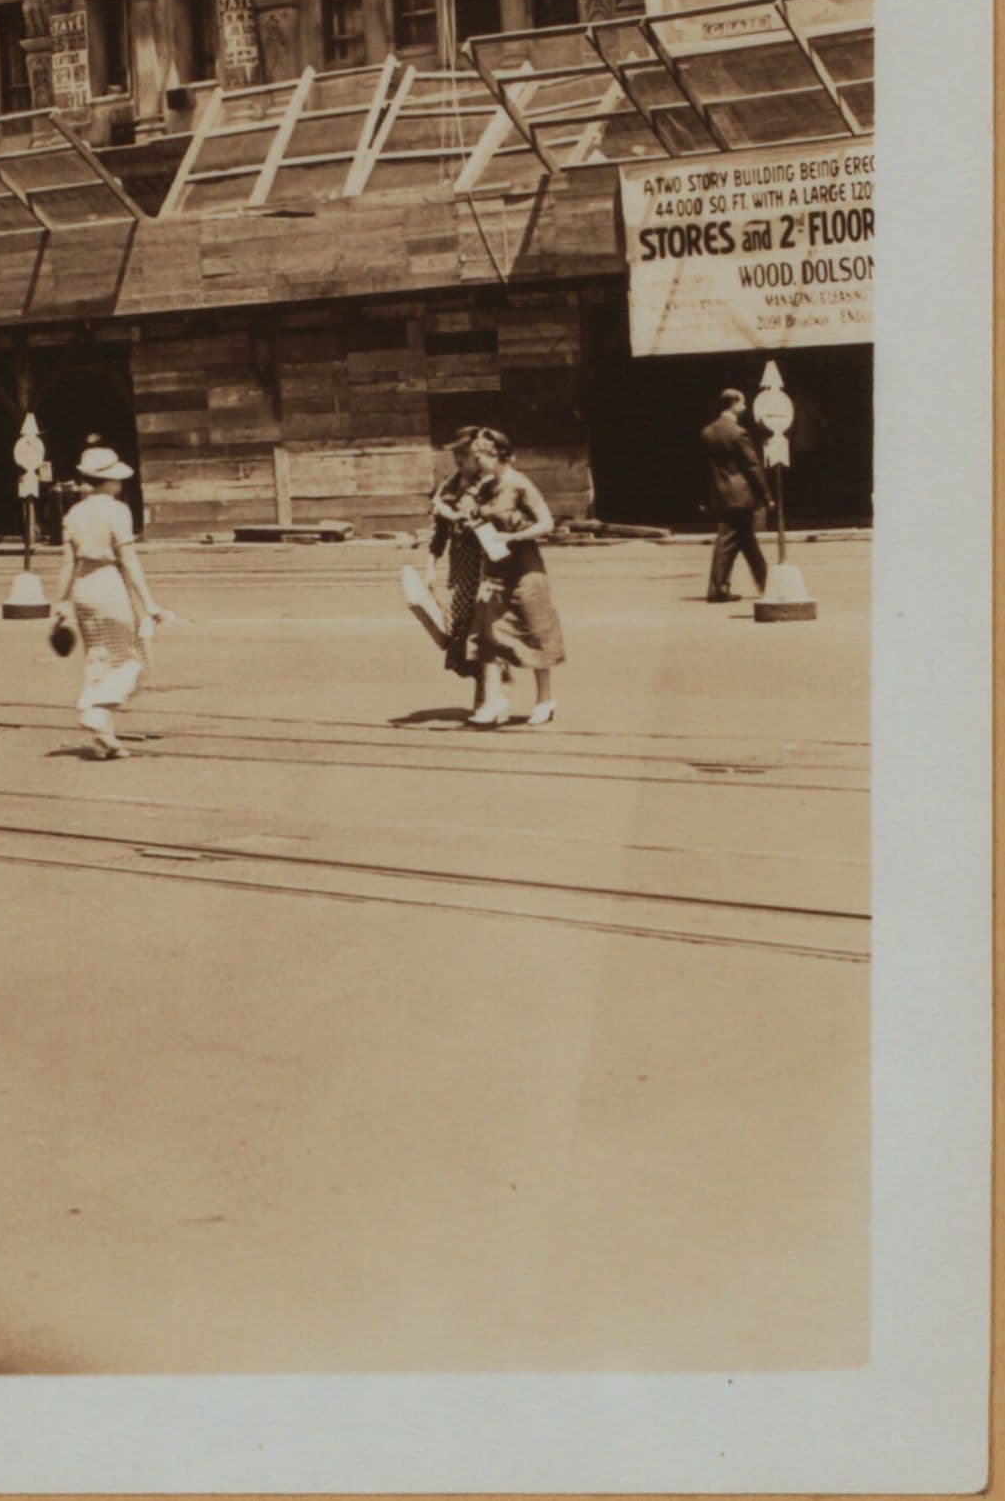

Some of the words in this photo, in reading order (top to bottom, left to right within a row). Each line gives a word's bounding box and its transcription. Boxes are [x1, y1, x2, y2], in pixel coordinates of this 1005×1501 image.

[644, 179, 654, 195] A
[655, 176, 681, 193] TWO
[688, 171, 728, 192] STORY
[734, 163, 795, 187] BUILDING
[800, 159, 839, 181] BEING
[752, 189, 784, 209] WITH
[789, 188, 798, 205] A
[803, 183, 846, 205] LARGE
[639, 220, 736, 262] STORES
[741, 219, 773, 252] and
[809, 207, 875, 247] FLOOR
